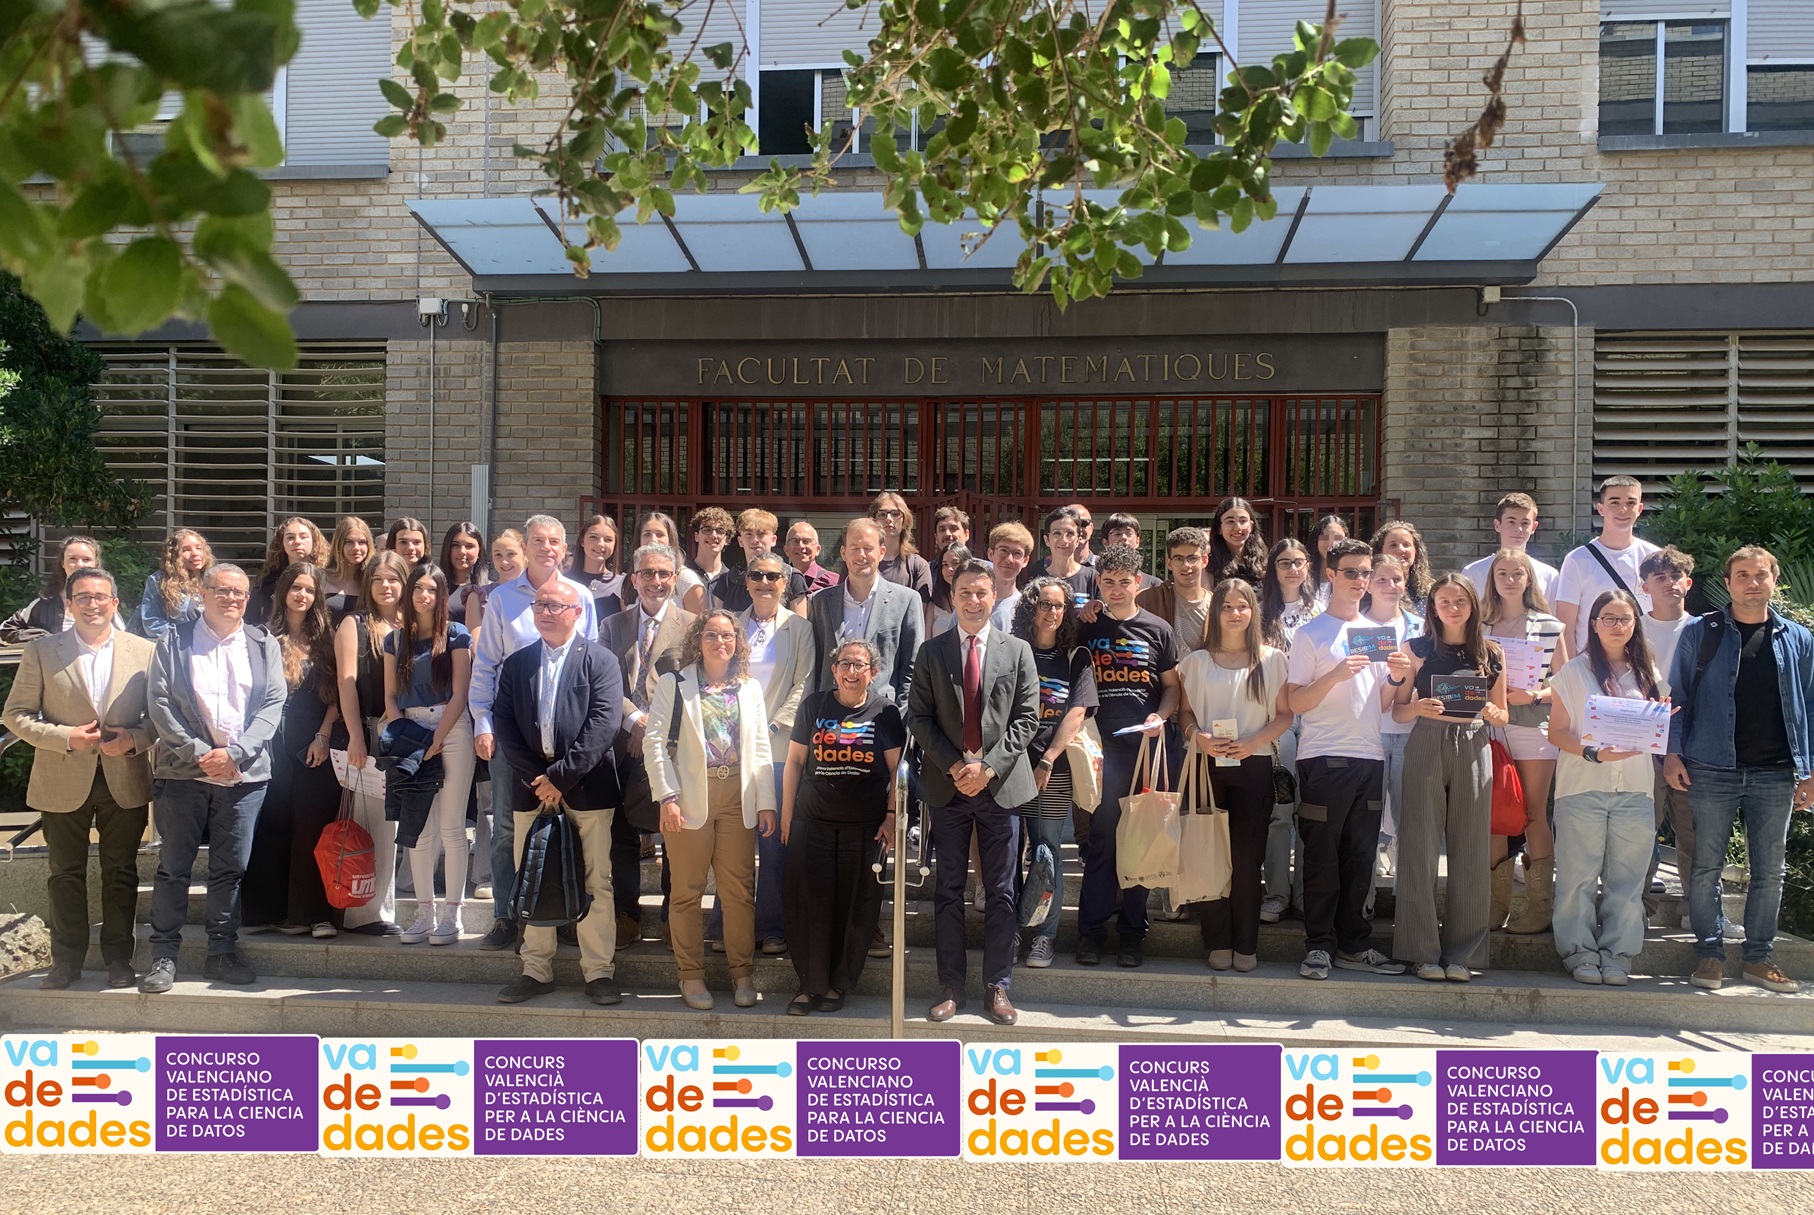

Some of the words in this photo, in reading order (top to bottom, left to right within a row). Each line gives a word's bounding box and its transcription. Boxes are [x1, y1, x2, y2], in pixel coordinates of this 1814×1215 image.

[697, 356, 876, 385] FACULTAT
[903, 356, 949, 385] DE
[1087, 637, 1110, 650] va
[816, 718, 838, 730] va
[812, 728, 837, 745] de
[813, 745, 875, 763] dades
